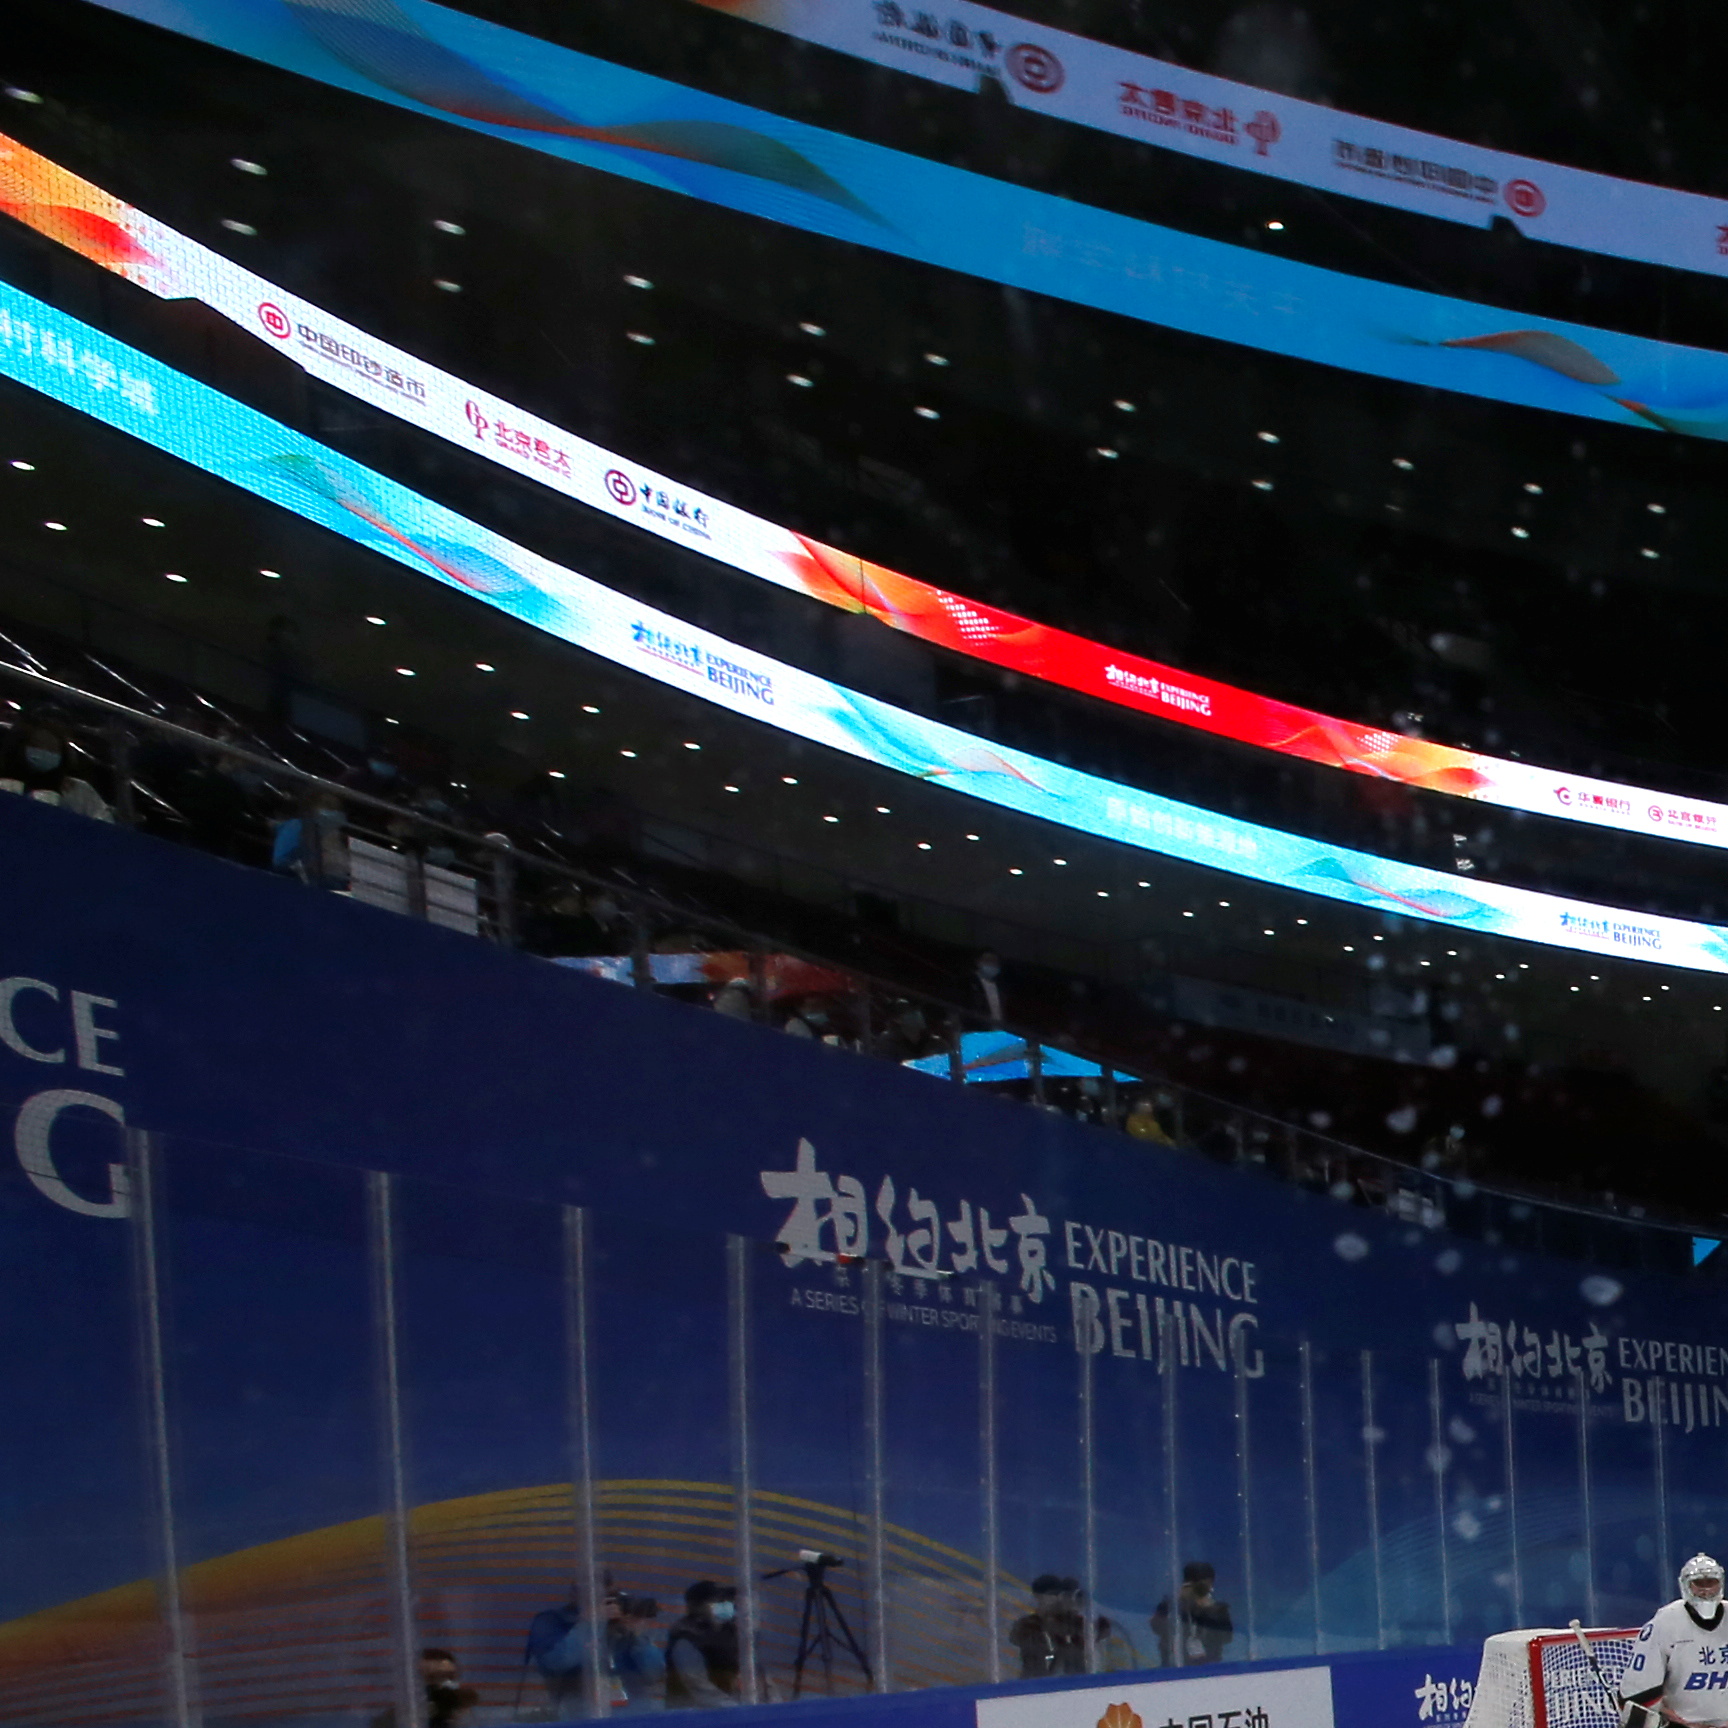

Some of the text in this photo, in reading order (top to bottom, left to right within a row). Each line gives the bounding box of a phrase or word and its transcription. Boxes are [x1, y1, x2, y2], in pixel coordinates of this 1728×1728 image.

[708, 665, 774, 705] BEIJING
[1162, 691, 1212, 716] BEIJING
[1613, 932, 1661, 949] BEIJING
[15, 1089, 136, 1218] G
[760, 1137, 1056, 1304] 相约北京
[1065, 1220, 1258, 1304] EXPERIENCE
[1069, 1281, 1266, 1379] BEIJING
[1455, 1301, 1613, 1393] 相约北京
[1415, 1674, 1474, 1720] 相约
